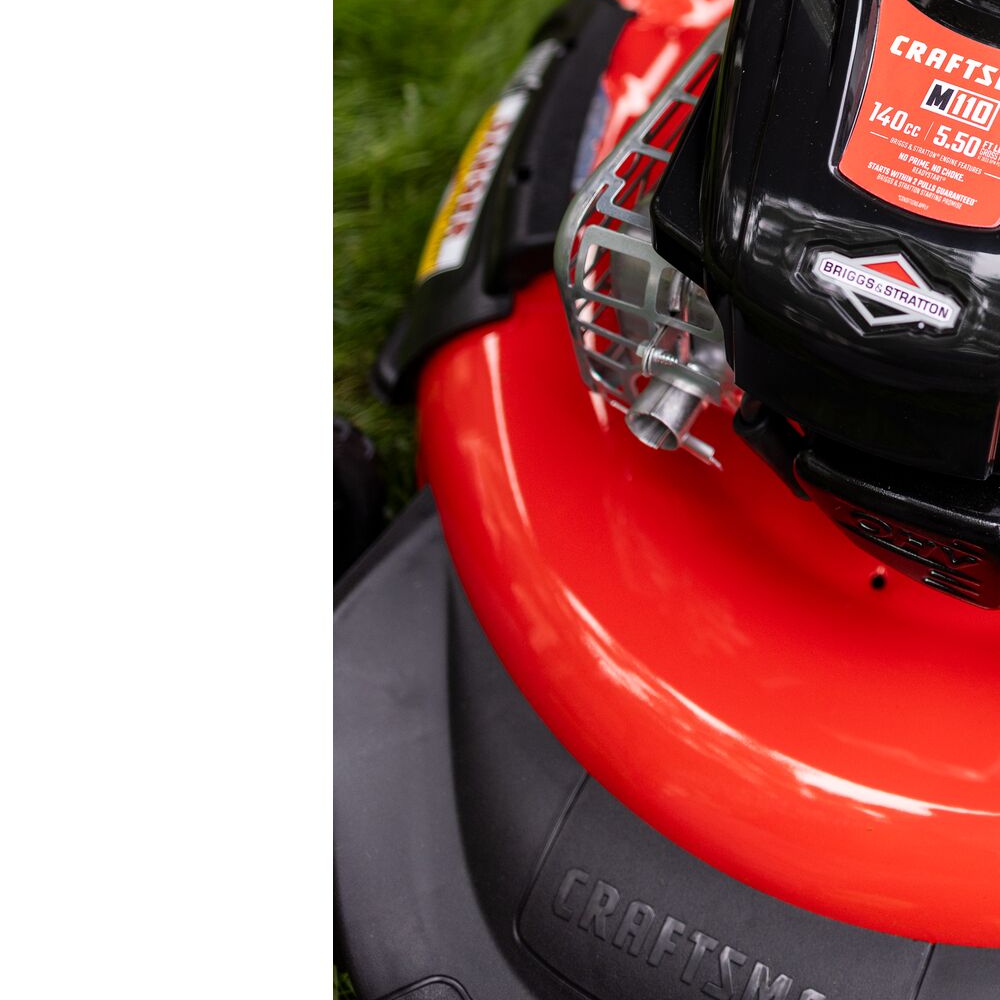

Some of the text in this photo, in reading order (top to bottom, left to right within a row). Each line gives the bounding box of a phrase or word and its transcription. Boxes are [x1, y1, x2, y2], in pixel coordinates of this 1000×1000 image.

[889, 137, 908, 149] BRIGGS
[939, 155, 958, 167] ENGINE
[957, 161, 983, 175] FEATURES
[933, 125, 982, 158] 5.50
[979, 148, 998, 161] GROSS
[982, 140, 994, 151] FT
[867, 161, 890, 175] STARTS
[890, 169, 913, 182] WITHIN
[917, 179, 937, 192] PULLS
[898, 152, 964, 182] NO PRIME, NO CHOKE.
[876, 173, 894, 185] BRIGGS
[898, 180, 921, 194] STRATTON
[920, 187, 942, 201] STARTING
[941, 195, 962, 210] PROMISE
